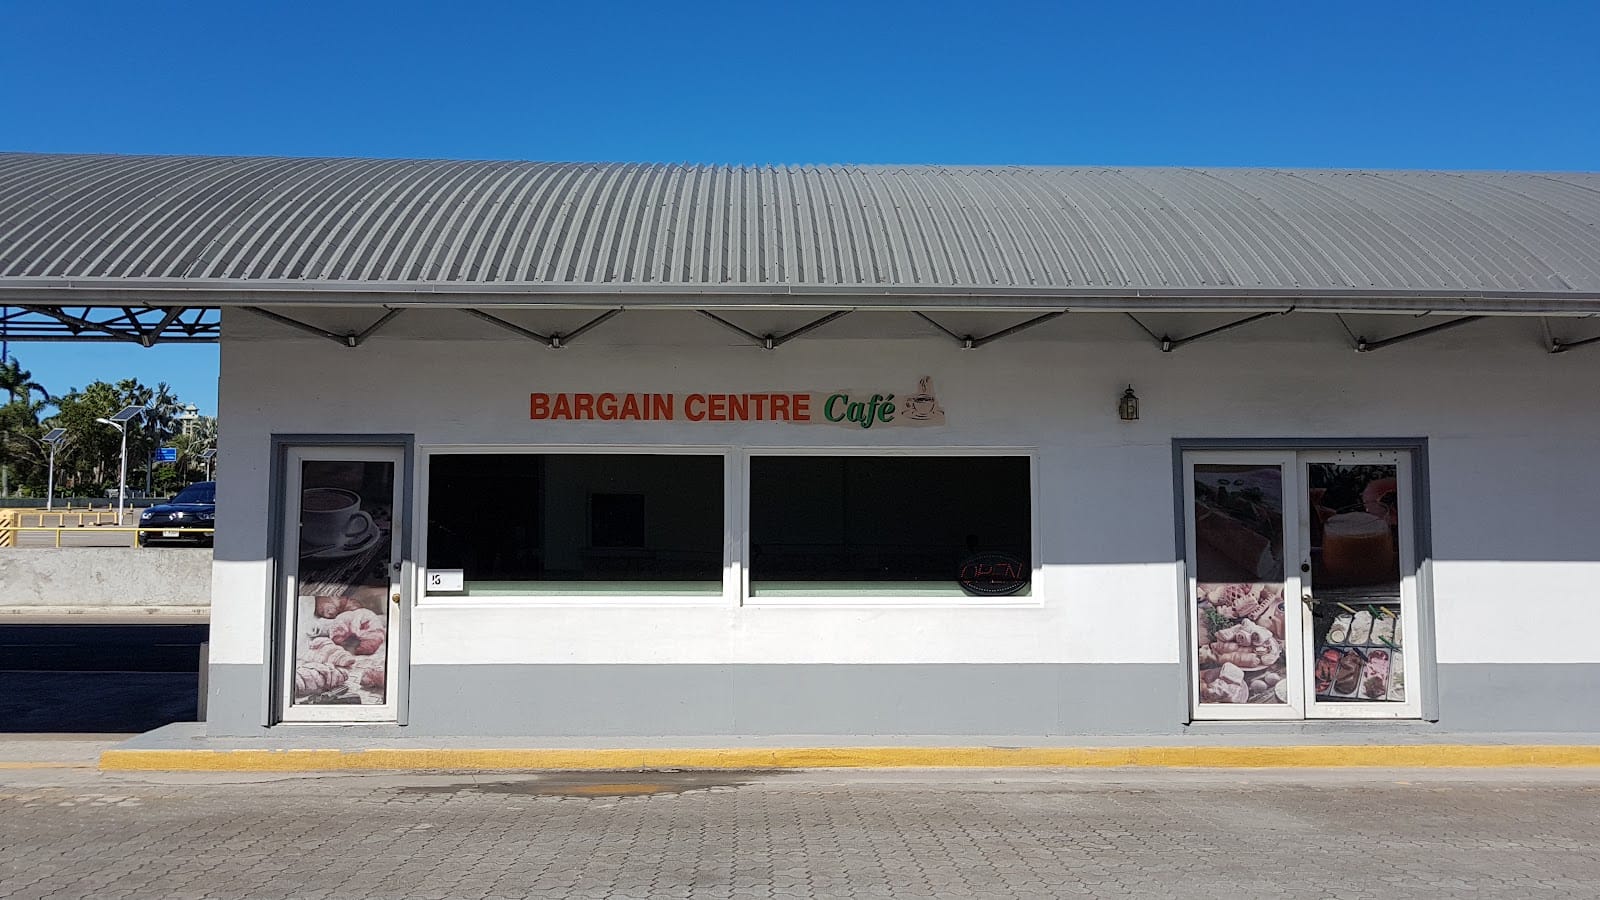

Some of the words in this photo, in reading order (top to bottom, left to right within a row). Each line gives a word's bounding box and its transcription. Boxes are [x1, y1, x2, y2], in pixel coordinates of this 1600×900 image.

[530, 393, 674, 420] BARGAIN
[684, 393, 811, 421] CENTRE
[824, 393, 896, 428] Café
[960, 560, 1024, 584] OPEN
